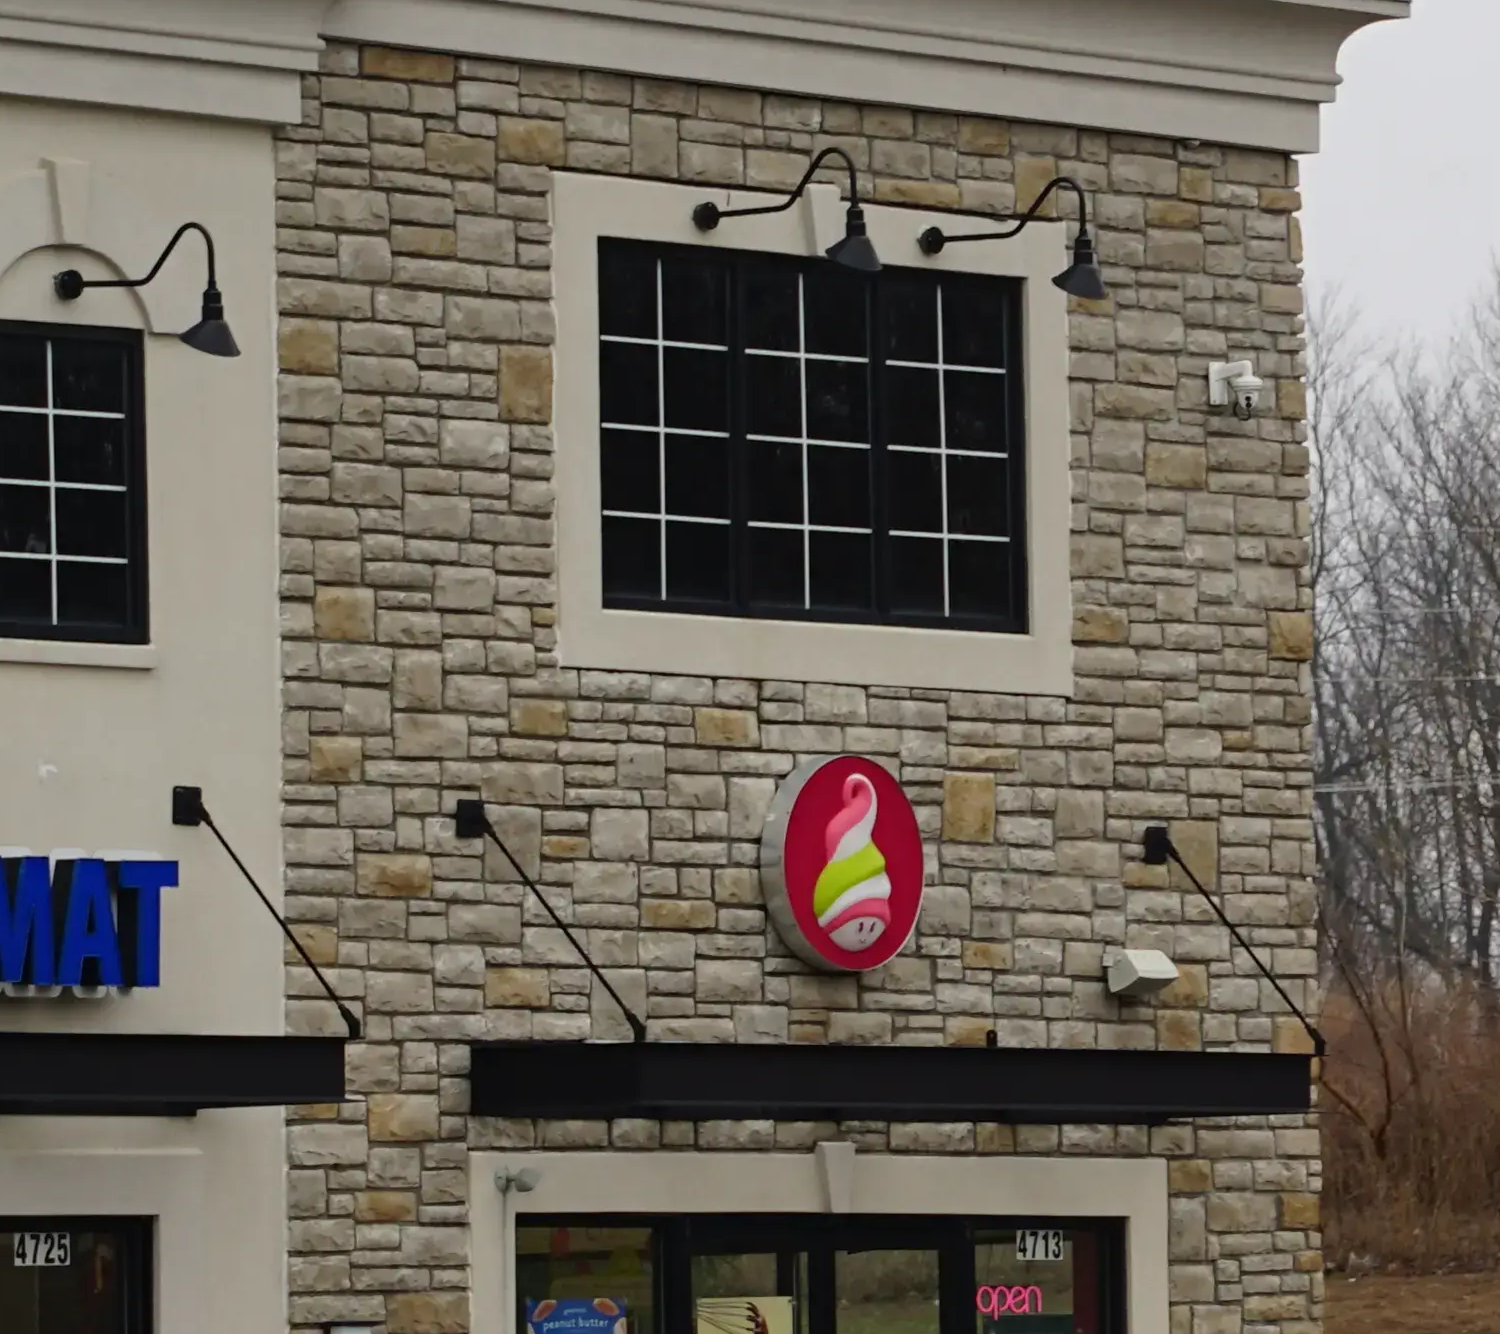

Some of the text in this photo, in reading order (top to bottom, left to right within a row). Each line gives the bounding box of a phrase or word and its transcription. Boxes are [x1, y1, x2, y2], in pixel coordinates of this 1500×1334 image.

[15, 1233, 69, 1265] 4725
[1018, 1230, 1062, 1259] 4713
[976, 1285, 1042, 1321] open
[543, 1317, 609, 1334] peanut butter
